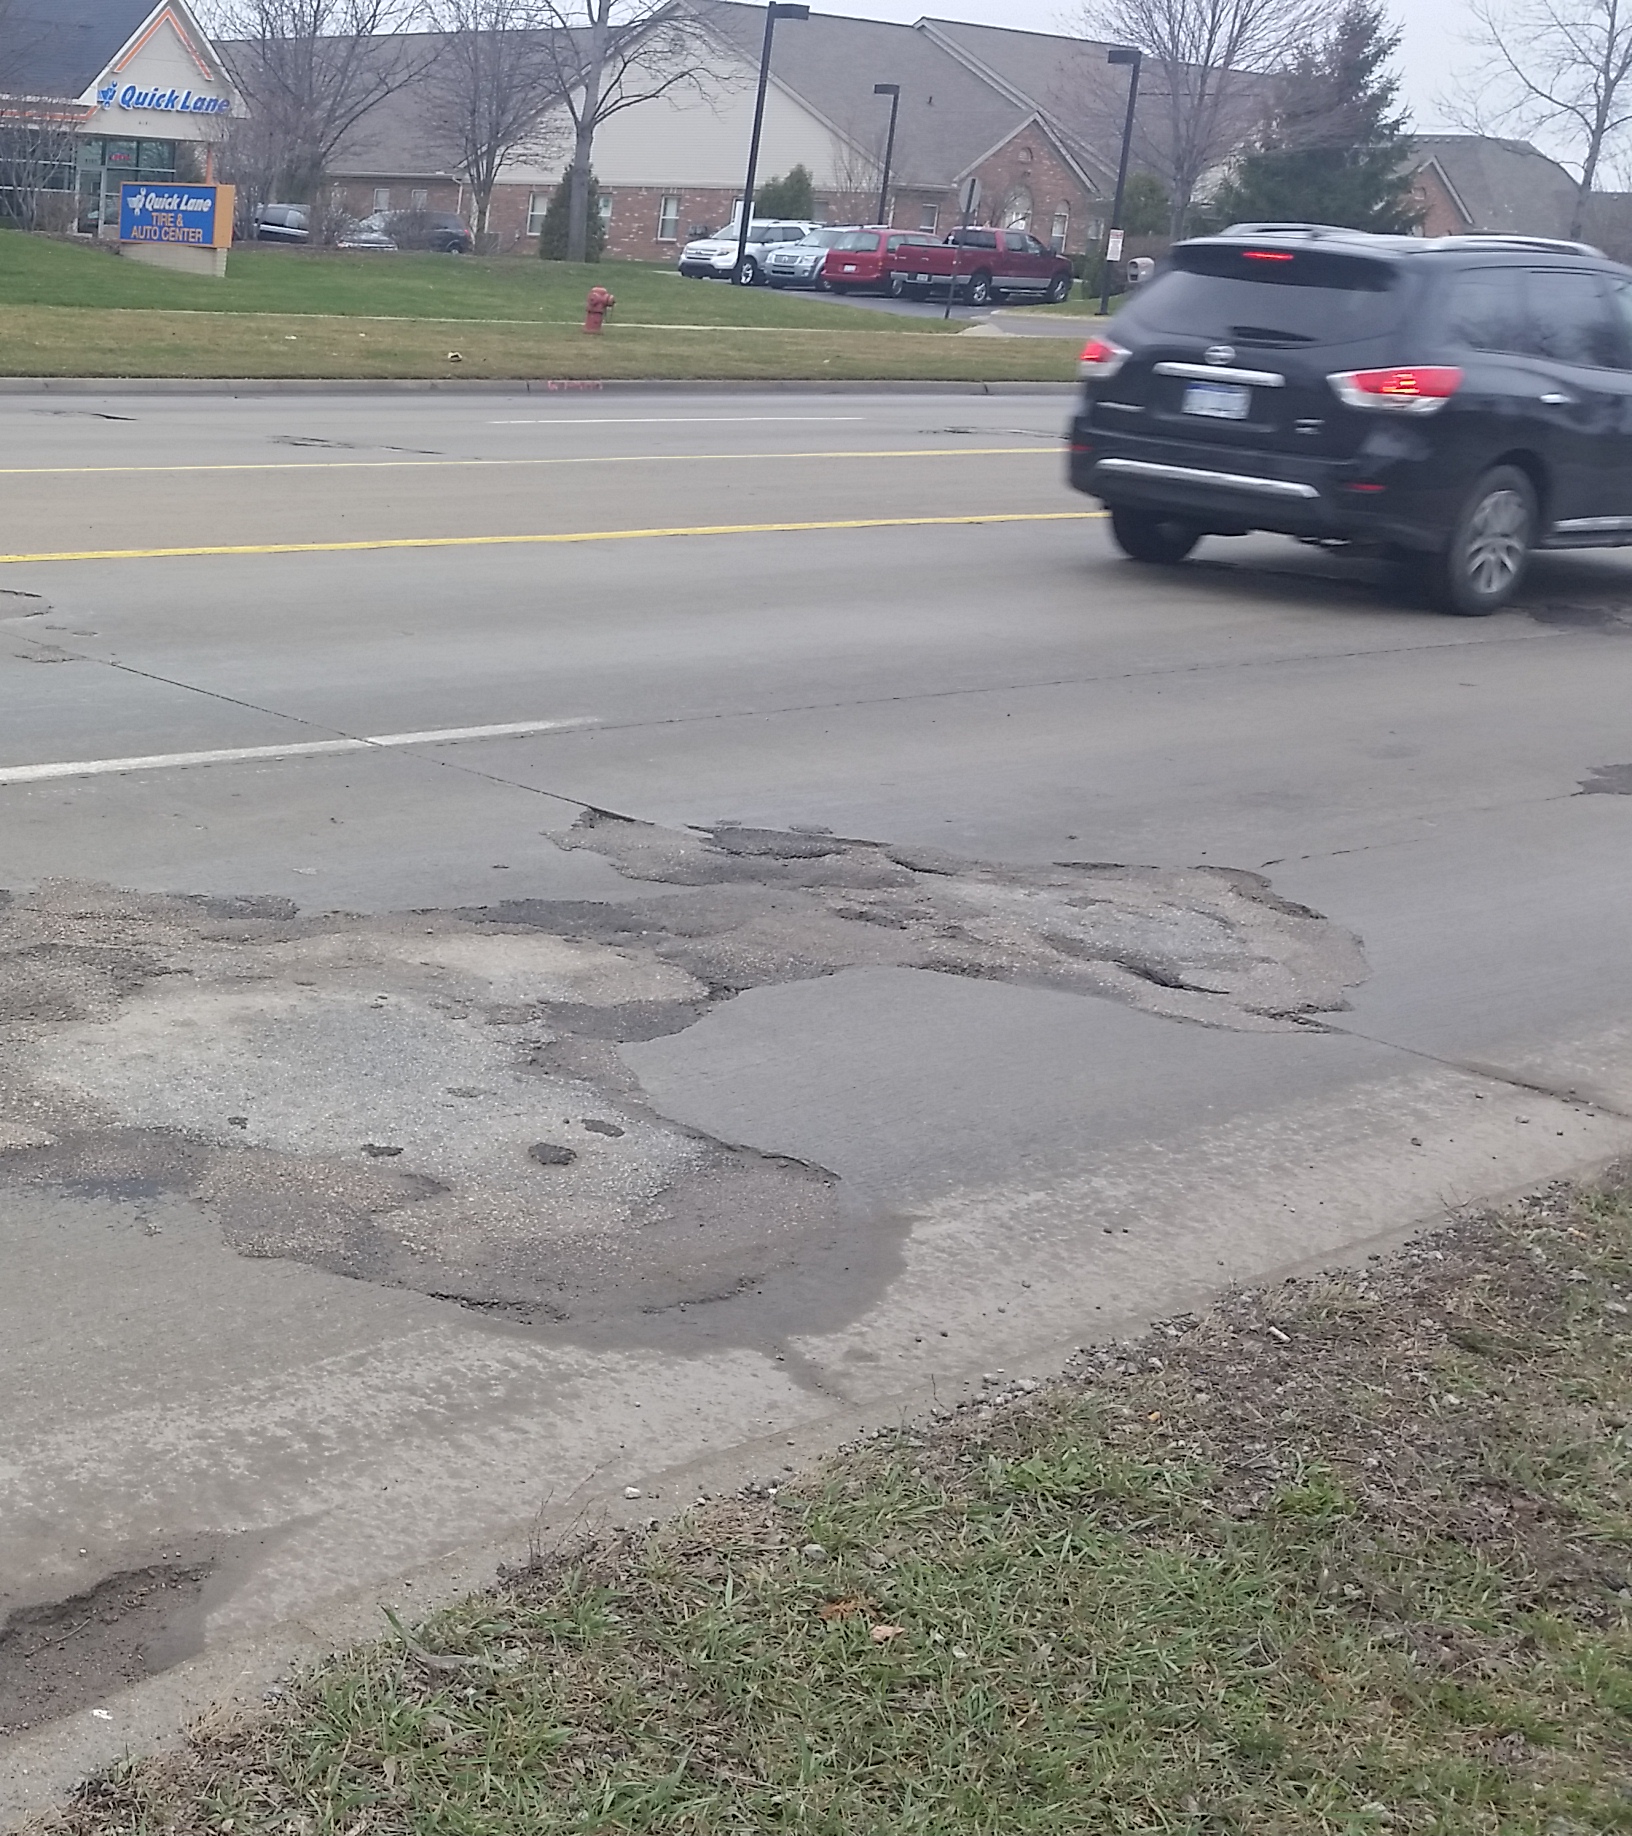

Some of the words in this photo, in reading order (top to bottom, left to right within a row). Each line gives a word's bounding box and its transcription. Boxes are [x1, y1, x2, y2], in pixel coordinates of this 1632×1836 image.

[120, 84, 179, 111] Quick
[177, 90, 231, 114] Lane
[145, 192, 180, 211] Quick
[179, 194, 212, 212] Lane
[151, 212, 175, 227] TIRE
[176, 213, 184, 227] &
[131, 225, 159, 240] AUTO
[161, 226, 203, 242] CENTER
